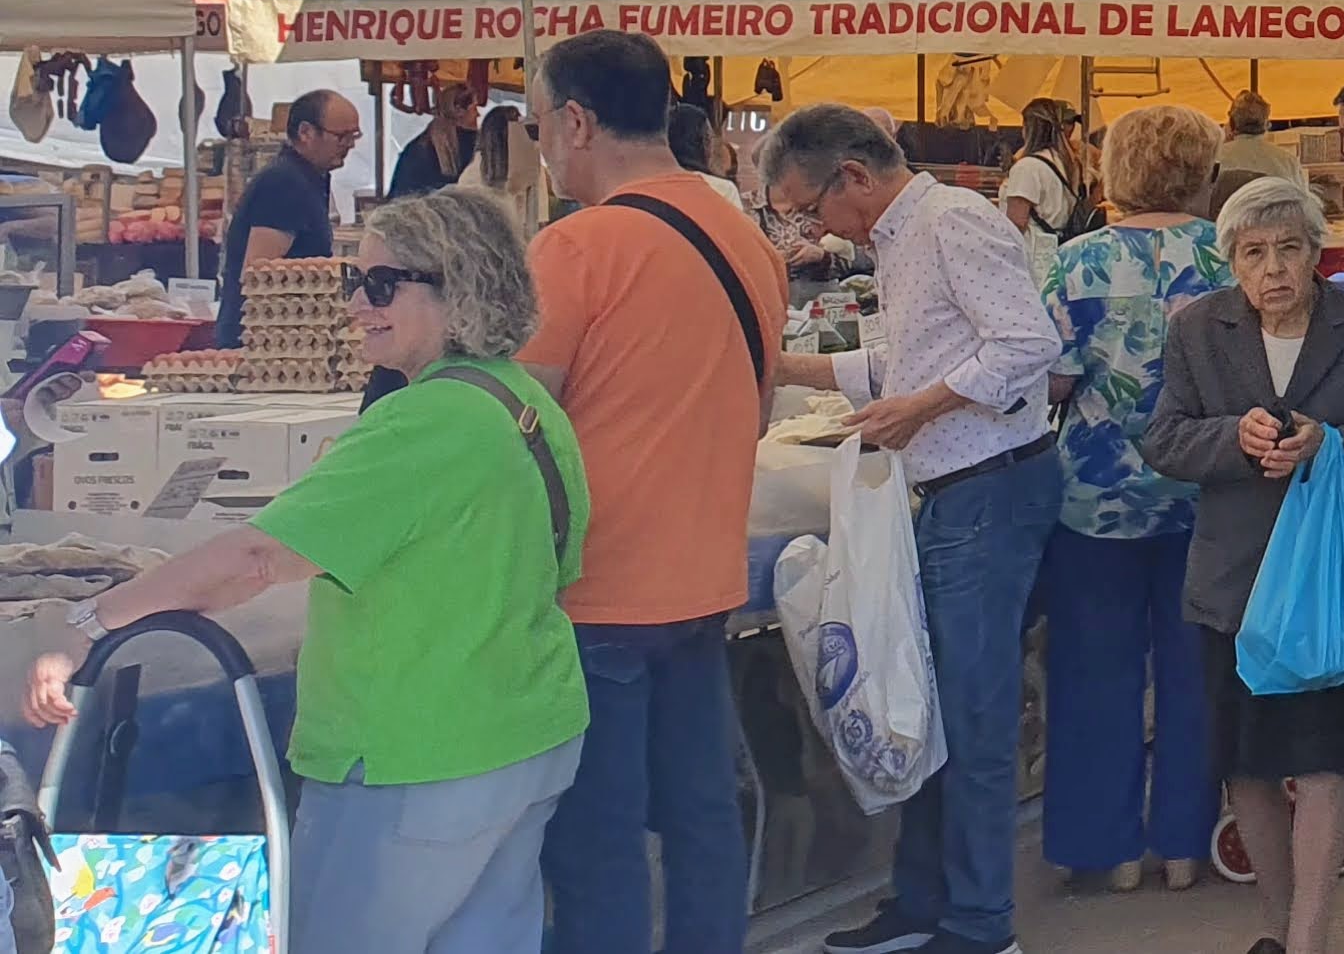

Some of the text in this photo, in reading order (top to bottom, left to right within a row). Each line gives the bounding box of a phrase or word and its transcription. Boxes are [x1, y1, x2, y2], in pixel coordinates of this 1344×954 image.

[277, 8, 463, 45] HENRIQUE
[474, 4, 605, 39] ROCHA
[618, 3, 794, 36] FUMEIRO
[809, 1, 1087, 36] TRADICIONAL
[1098, 2, 1154, 36] DE
